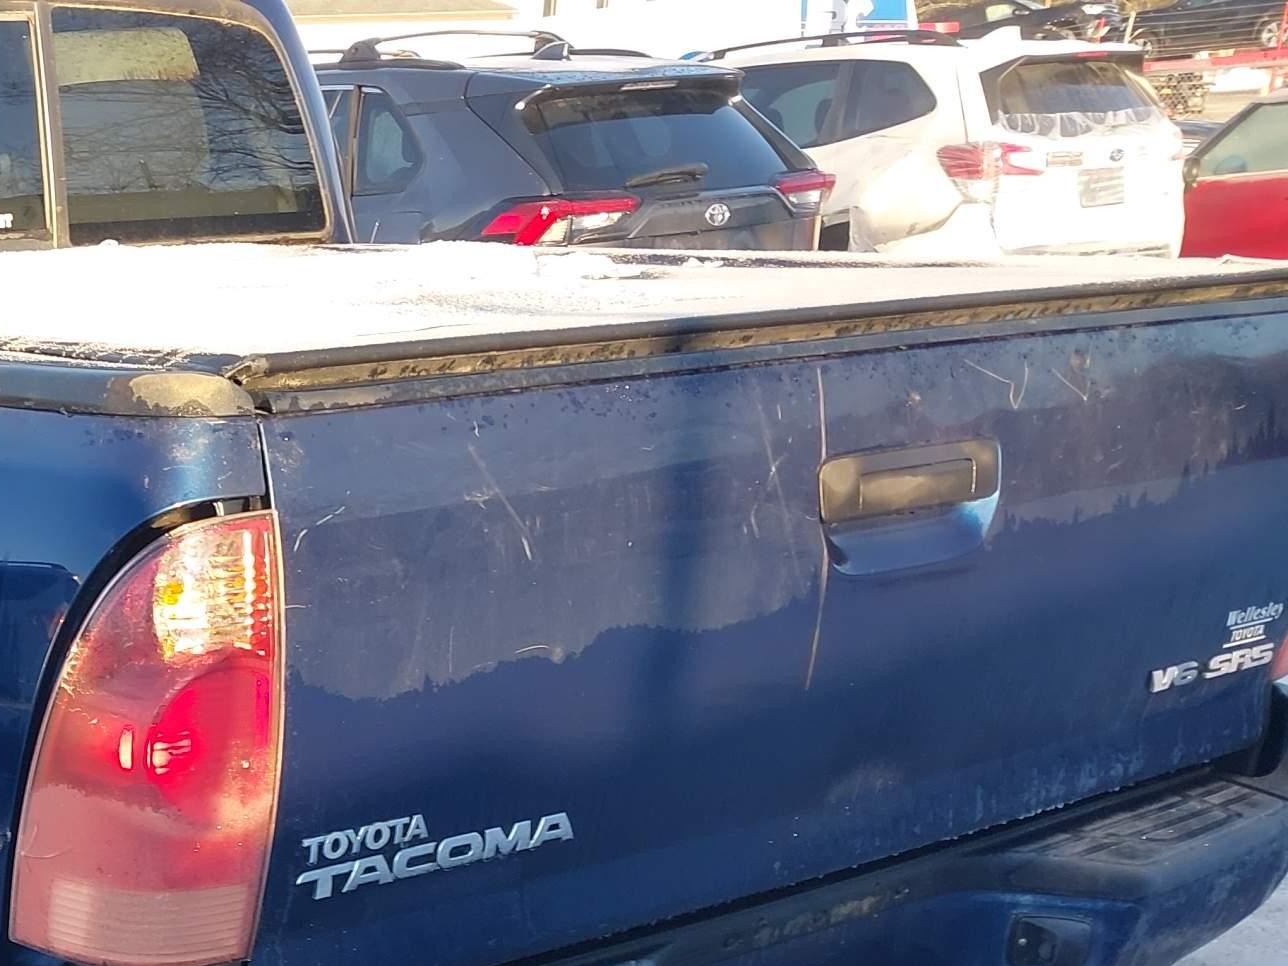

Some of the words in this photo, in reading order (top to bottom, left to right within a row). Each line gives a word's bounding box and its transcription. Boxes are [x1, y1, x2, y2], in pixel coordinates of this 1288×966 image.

[1226, 602, 1284, 627] Wellesley
[1230, 624, 1266, 642] TOYOTA
[1151, 661, 1199, 693] V6
[296, 812, 574, 900] TACOMA
[302, 814, 429, 866] TOYOTA
